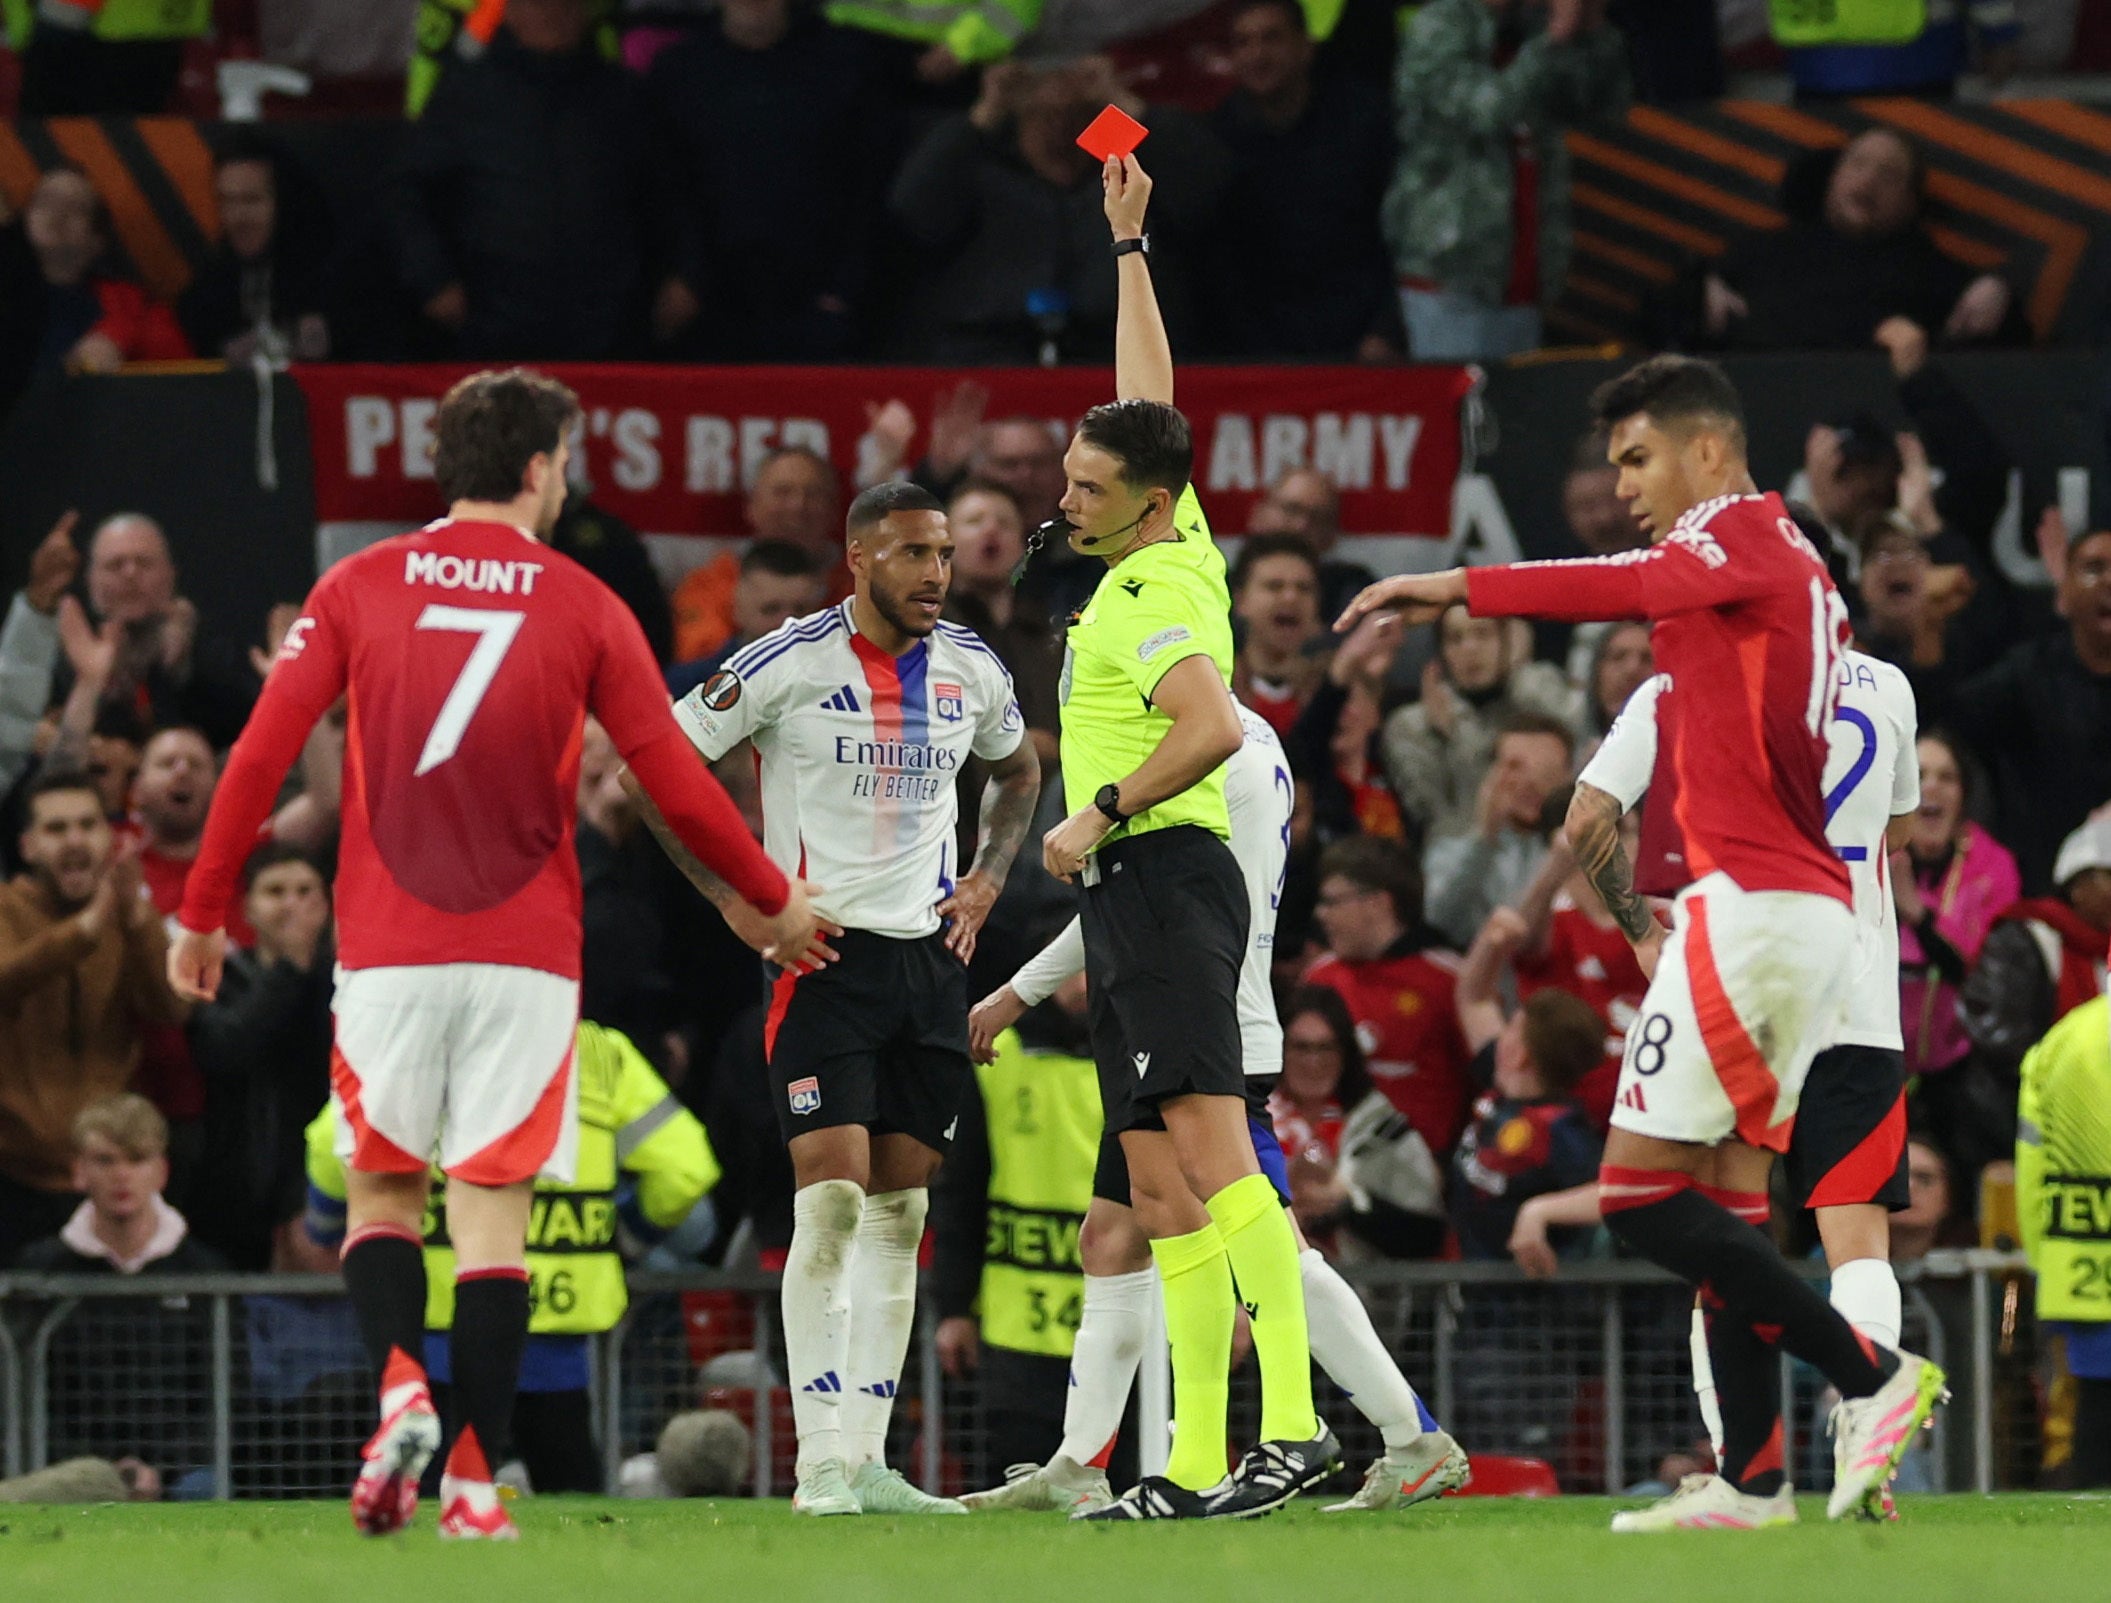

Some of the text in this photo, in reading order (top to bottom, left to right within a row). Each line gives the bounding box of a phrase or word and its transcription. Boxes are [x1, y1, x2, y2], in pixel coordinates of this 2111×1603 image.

[345, 395, 662, 490] PE'S
[1206, 411, 1424, 492] ARMY
[404, 551, 545, 596] MOUNT
[413, 602, 528, 778] 7
[834, 735, 958, 771] Emirates
[852, 773, 939, 801] FLY BETTER
